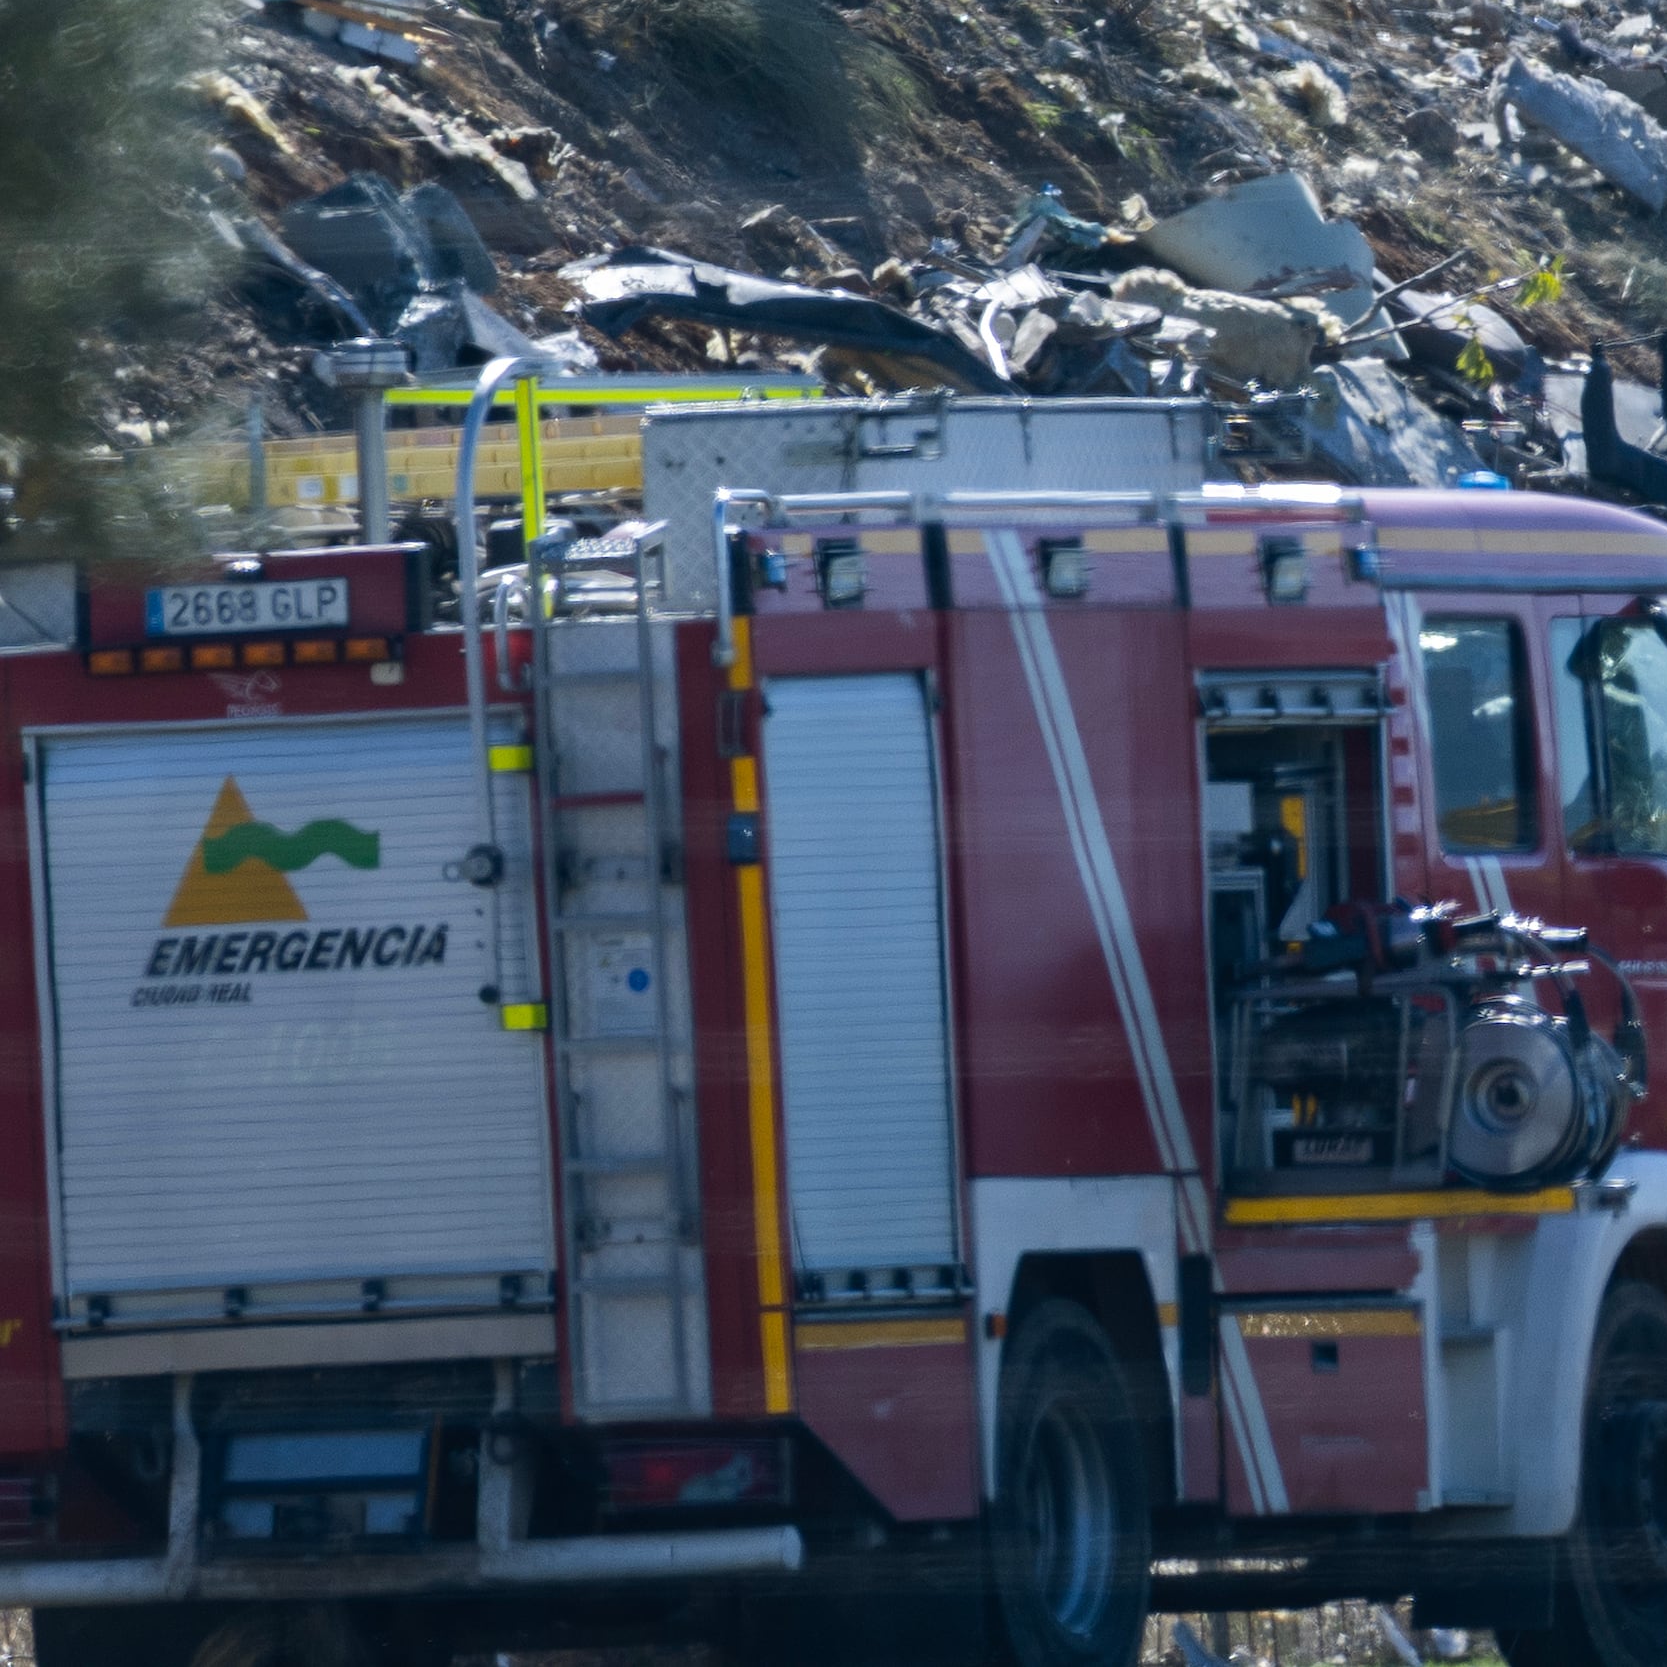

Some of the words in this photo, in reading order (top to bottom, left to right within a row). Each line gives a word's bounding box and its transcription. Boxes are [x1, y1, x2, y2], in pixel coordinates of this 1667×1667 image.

[169, 589, 257, 628] 2668
[271, 586, 338, 622] GLP
[143, 923, 449, 979] EMERGENCIA
